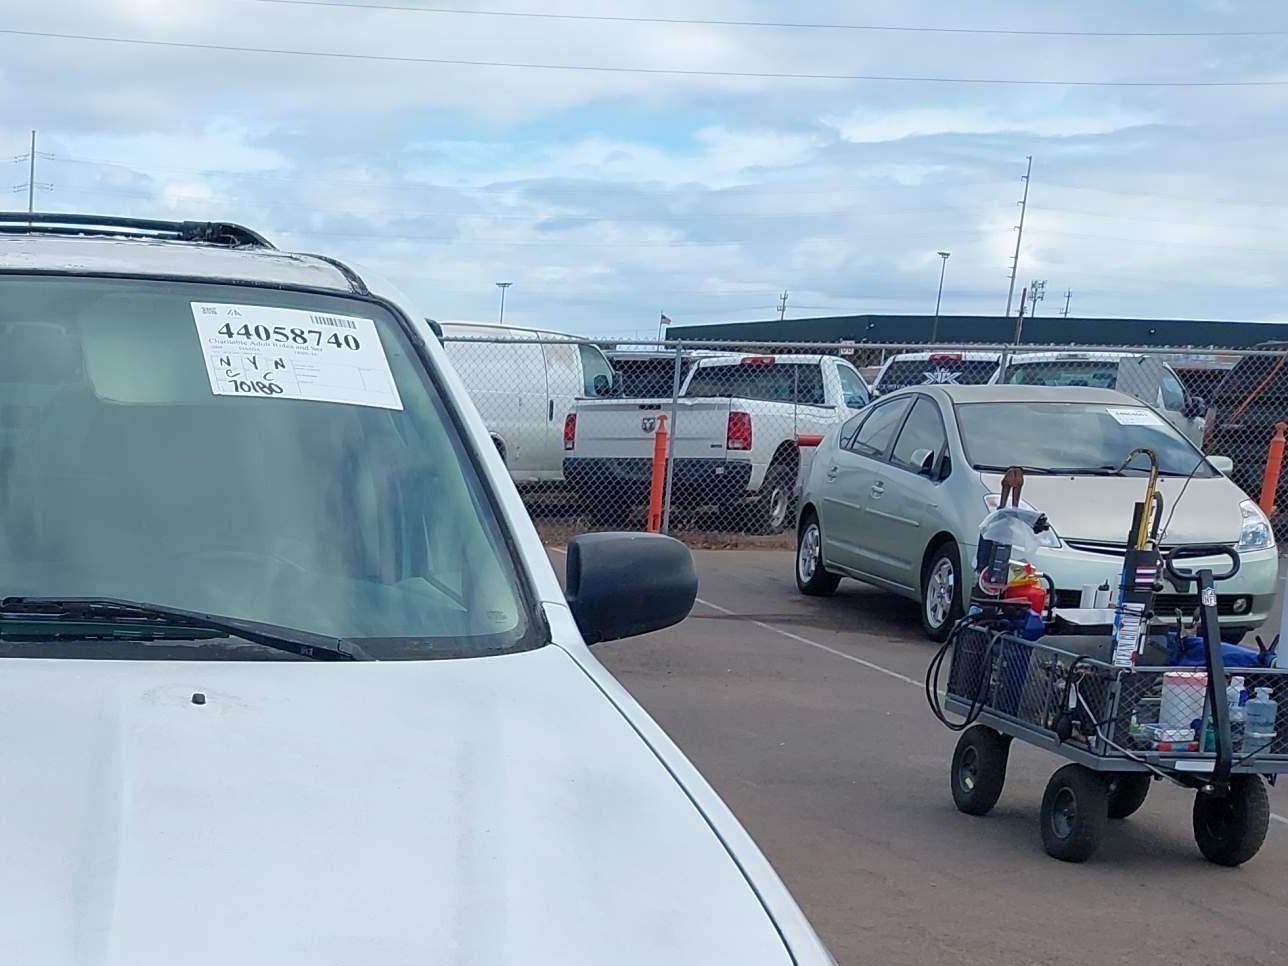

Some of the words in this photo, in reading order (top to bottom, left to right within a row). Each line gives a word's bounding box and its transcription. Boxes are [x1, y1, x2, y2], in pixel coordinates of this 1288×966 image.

[218, 322, 360, 351] 44058740
[219, 355, 231, 367] N
[247, 355, 258, 370] Y
[274, 357, 286, 370] N
[228, 380, 284, 395] 70180
